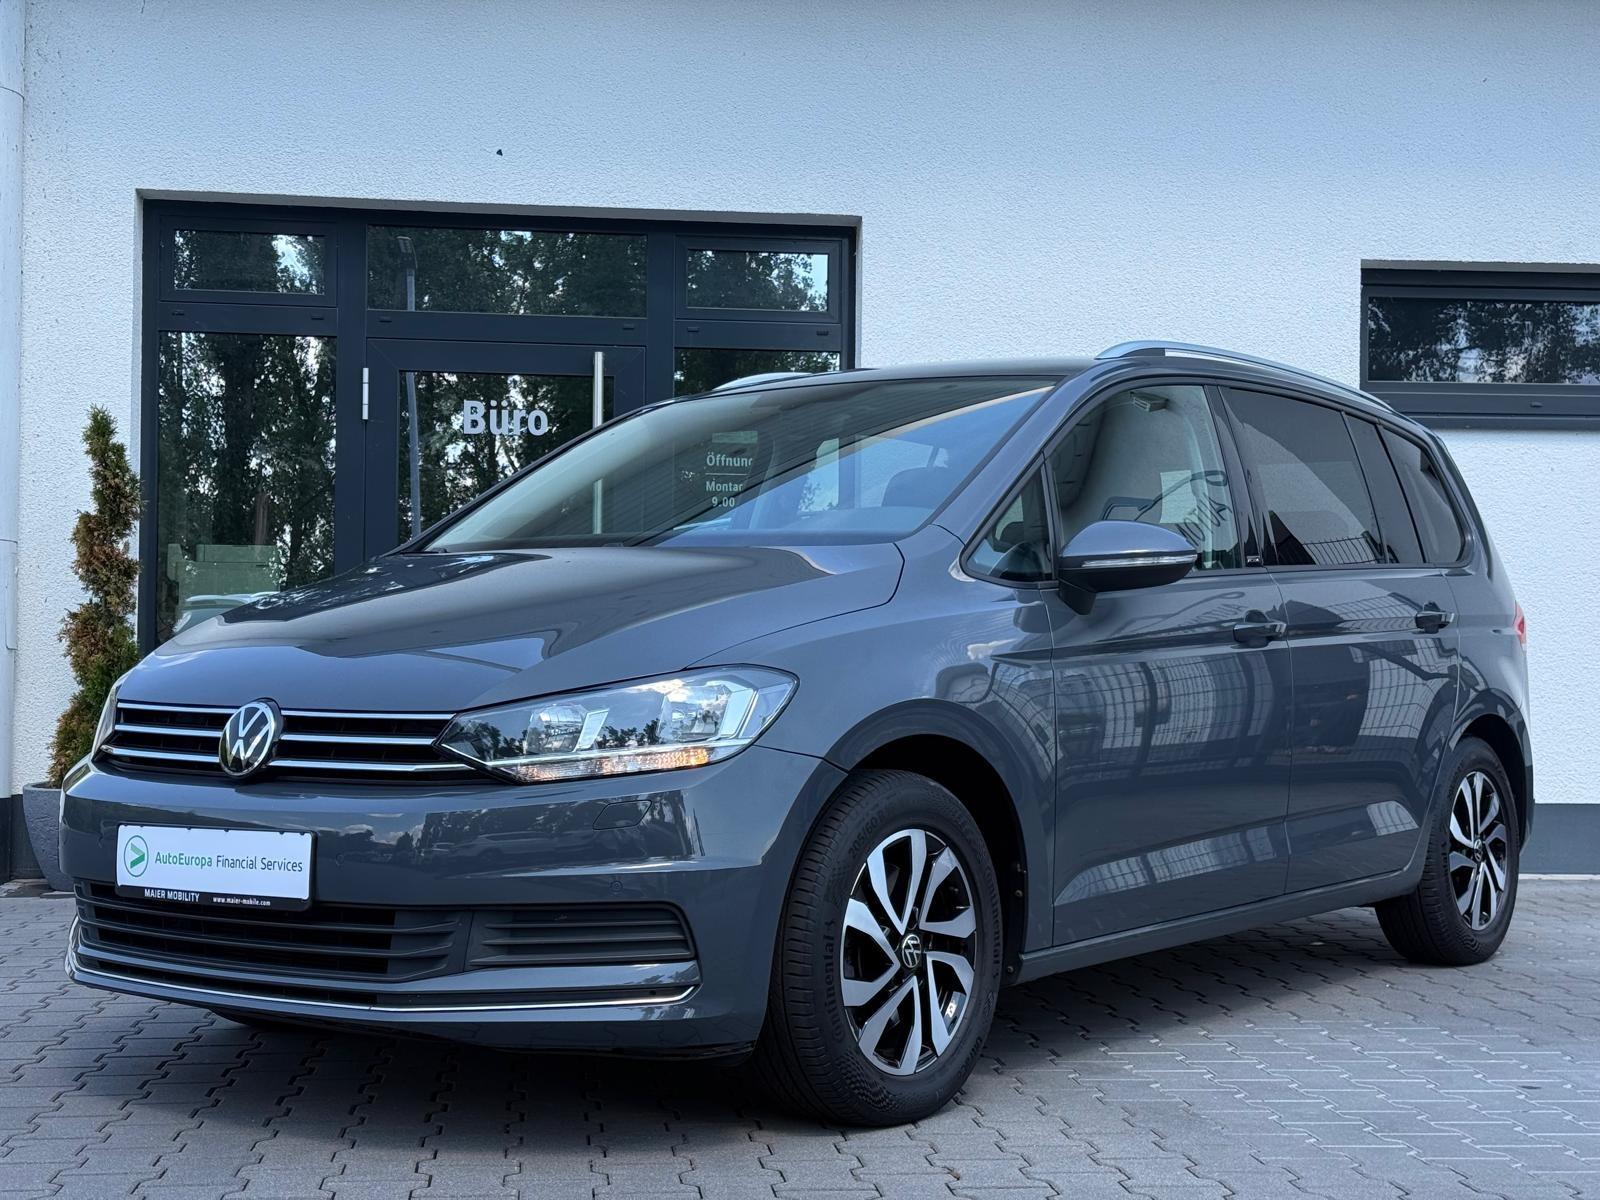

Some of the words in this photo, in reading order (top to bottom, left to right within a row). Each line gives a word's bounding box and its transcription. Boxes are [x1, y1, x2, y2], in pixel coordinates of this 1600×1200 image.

[463, 400, 549, 436] Büro
[154, 851, 213, 869] AutoEuropa
[216, 855, 257, 870] Financial
[260, 857, 303, 872] Services
[144, 888, 166, 899] MAIER
[167, 890, 200, 902] MOBILITY
[213, 897, 271, 906] www.maier-mobile.com
